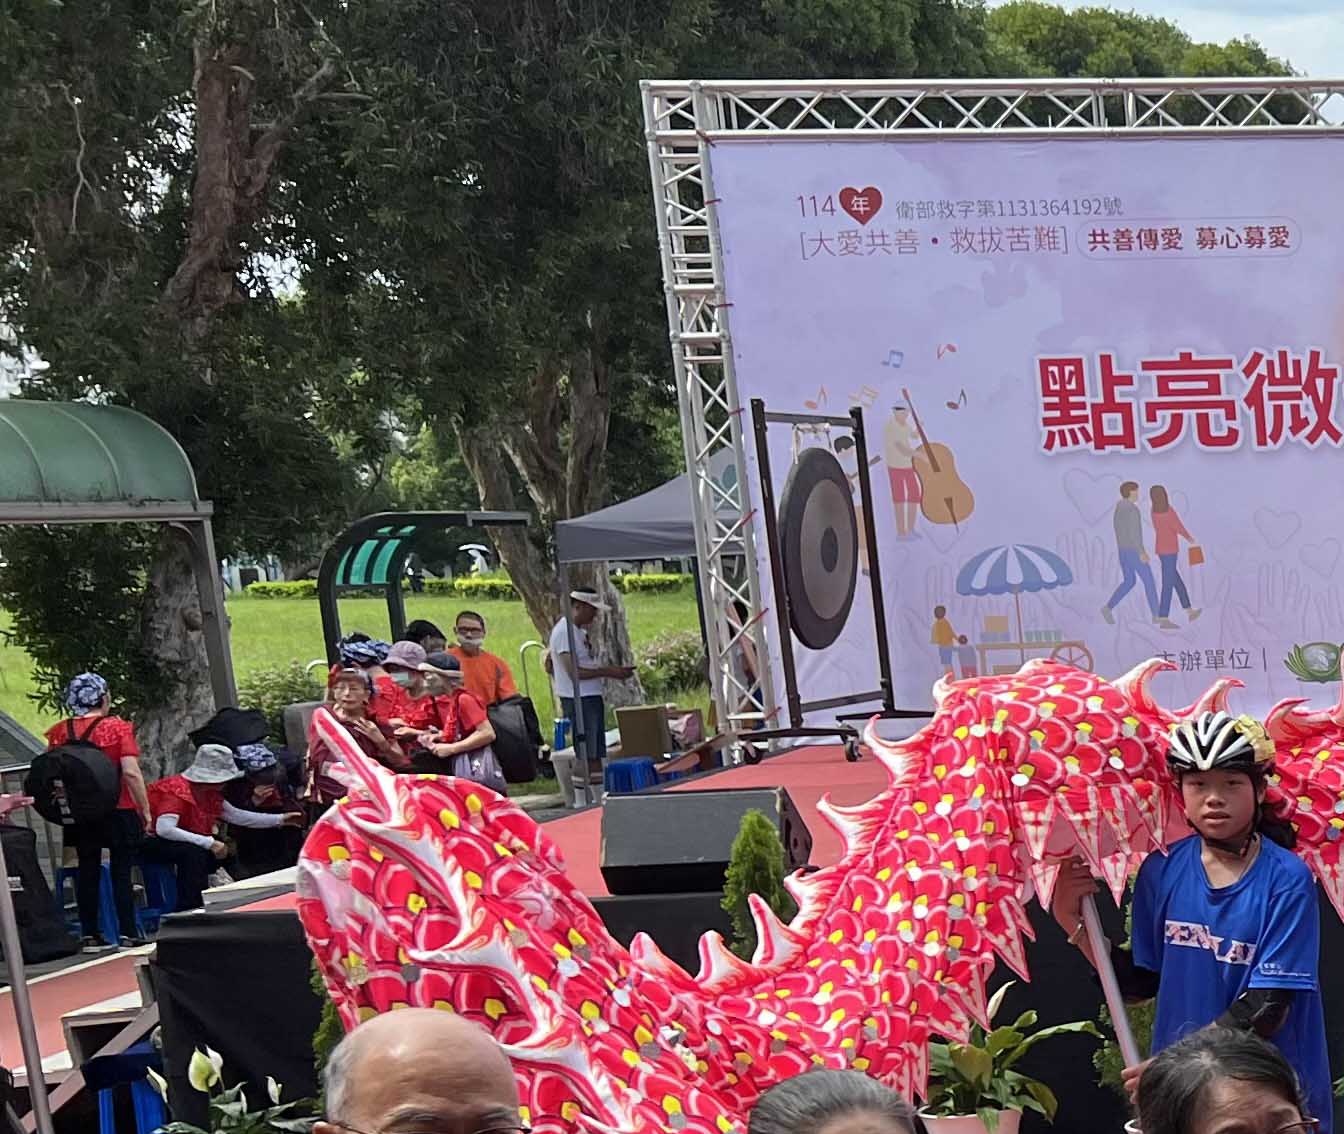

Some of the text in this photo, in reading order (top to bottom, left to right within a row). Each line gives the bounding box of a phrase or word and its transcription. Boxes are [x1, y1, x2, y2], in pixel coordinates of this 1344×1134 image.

[797, 195, 837, 217] 114
[850, 195, 871, 214] 年
[1088, 228, 1183, 252] 共善傳愛
